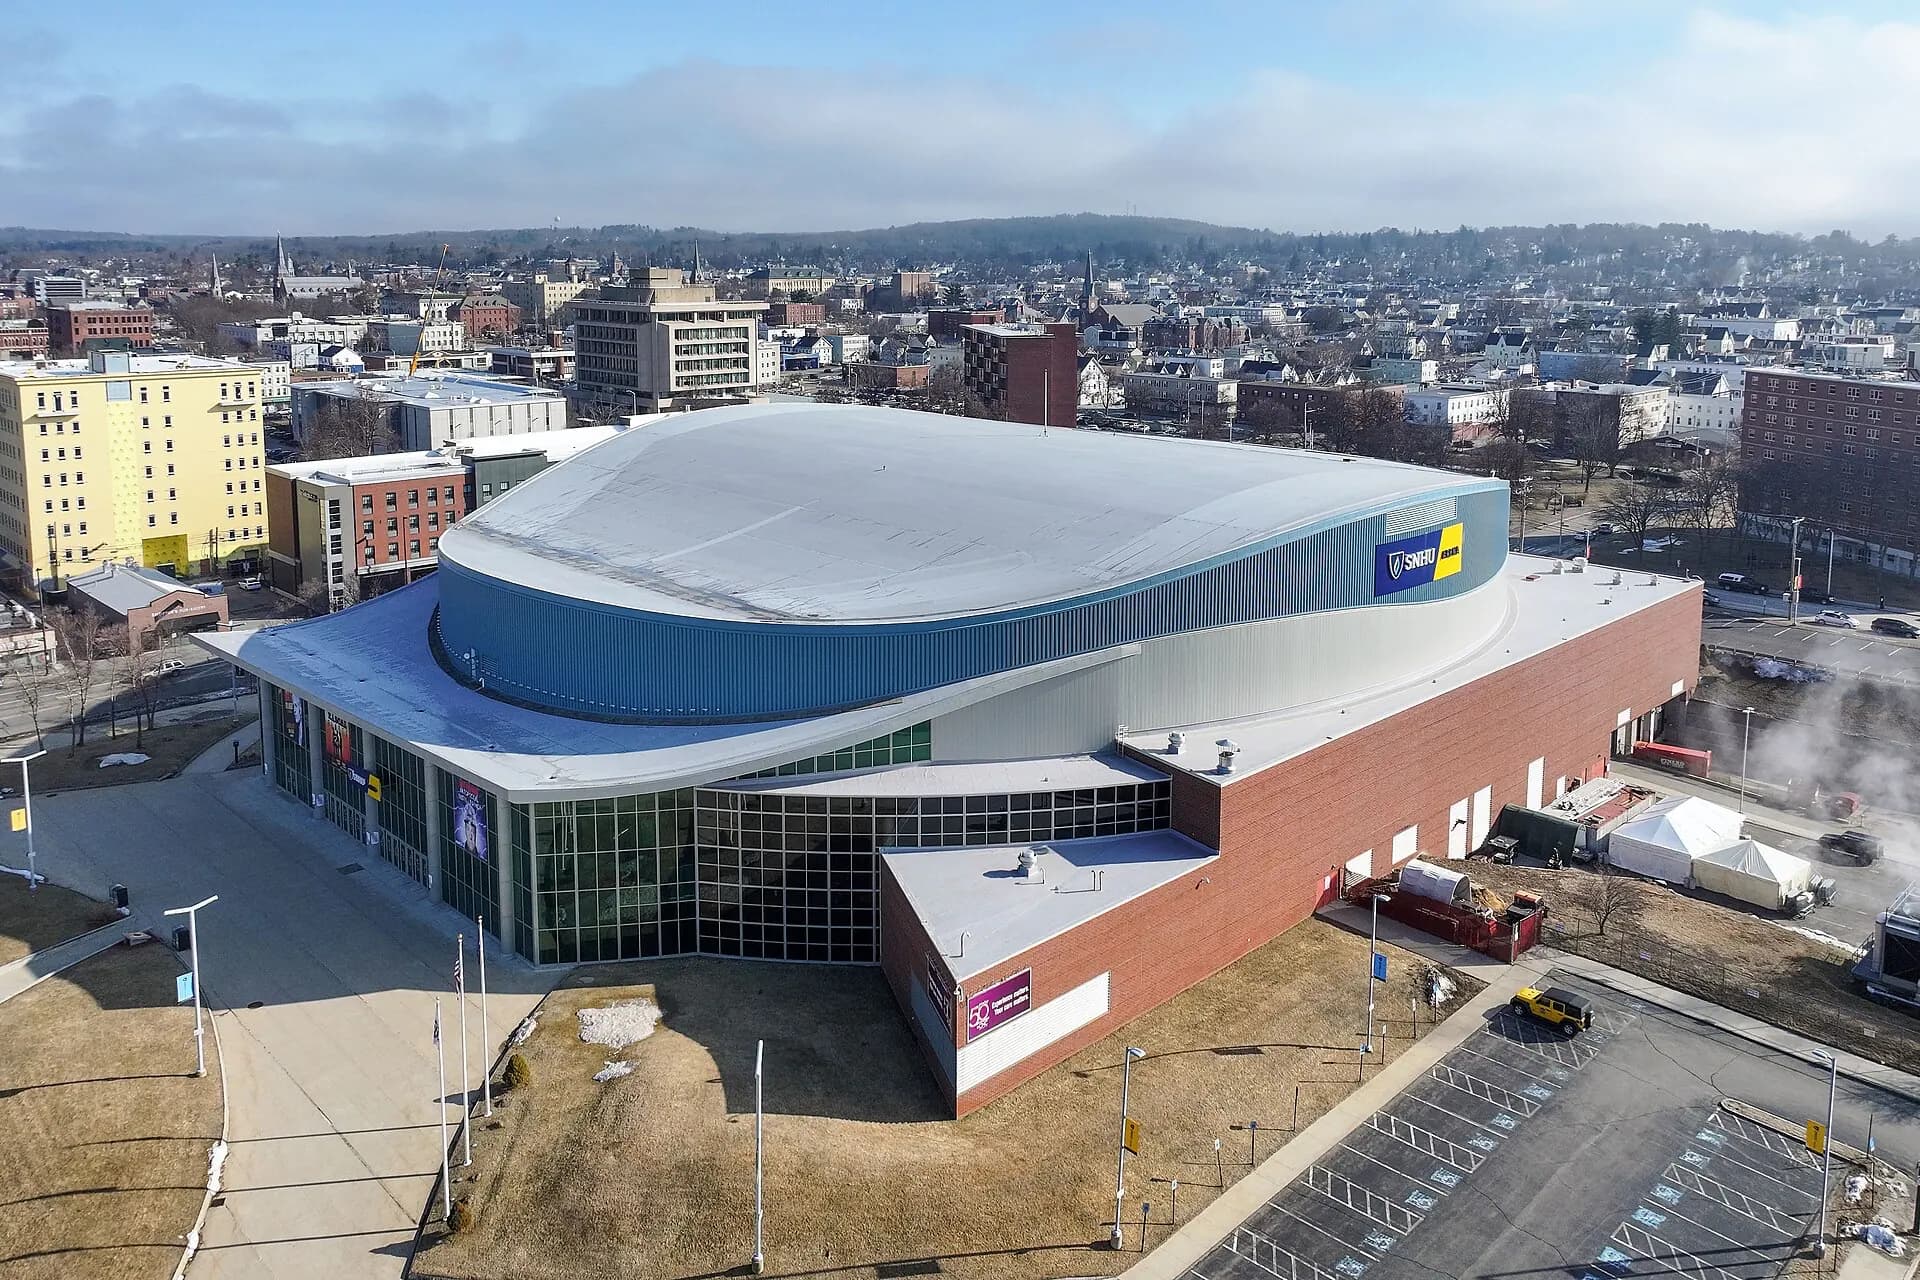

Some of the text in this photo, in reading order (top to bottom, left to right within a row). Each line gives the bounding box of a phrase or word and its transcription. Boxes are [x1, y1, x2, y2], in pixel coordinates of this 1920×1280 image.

[1404, 548, 1435, 570] SNHU
[991, 994, 1012, 1009] Experience
[970, 1001, 990, 1028] 50
[994, 1006, 1004, 1016] Your
